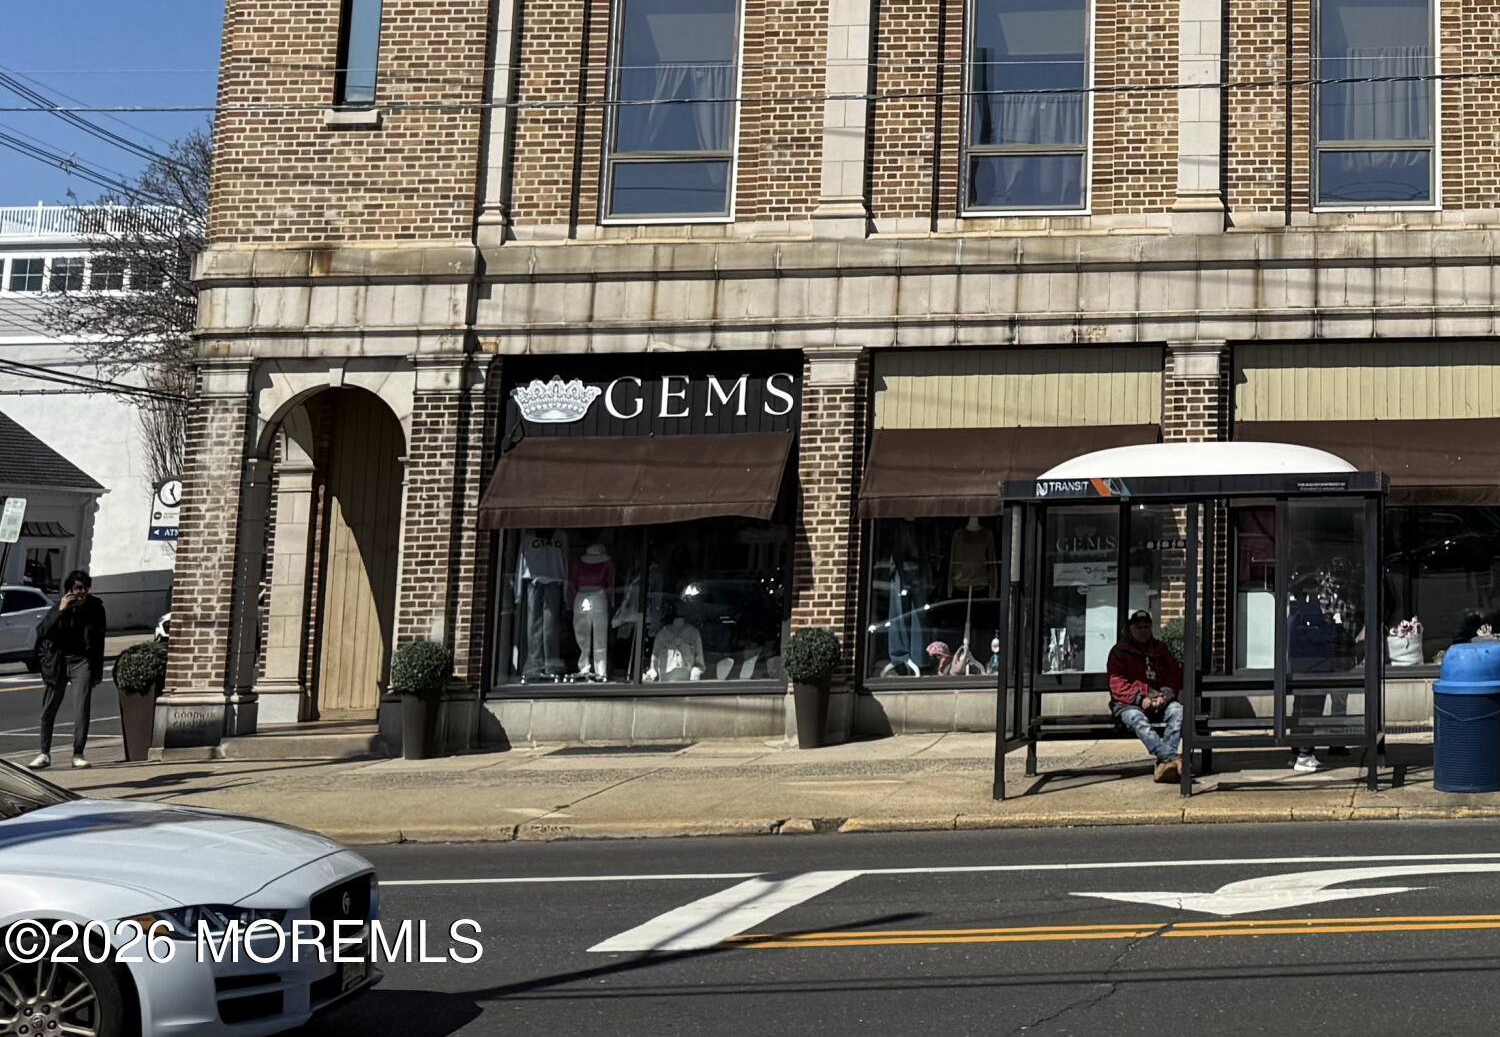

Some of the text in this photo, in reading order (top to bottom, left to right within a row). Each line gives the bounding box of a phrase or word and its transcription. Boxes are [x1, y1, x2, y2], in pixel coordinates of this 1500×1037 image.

[604, 372, 795, 419] GEMS
[1049, 481, 1089, 492] TRANSIT
[164, 528, 179, 536] AT
[1055, 536, 1116, 553] GEMS
